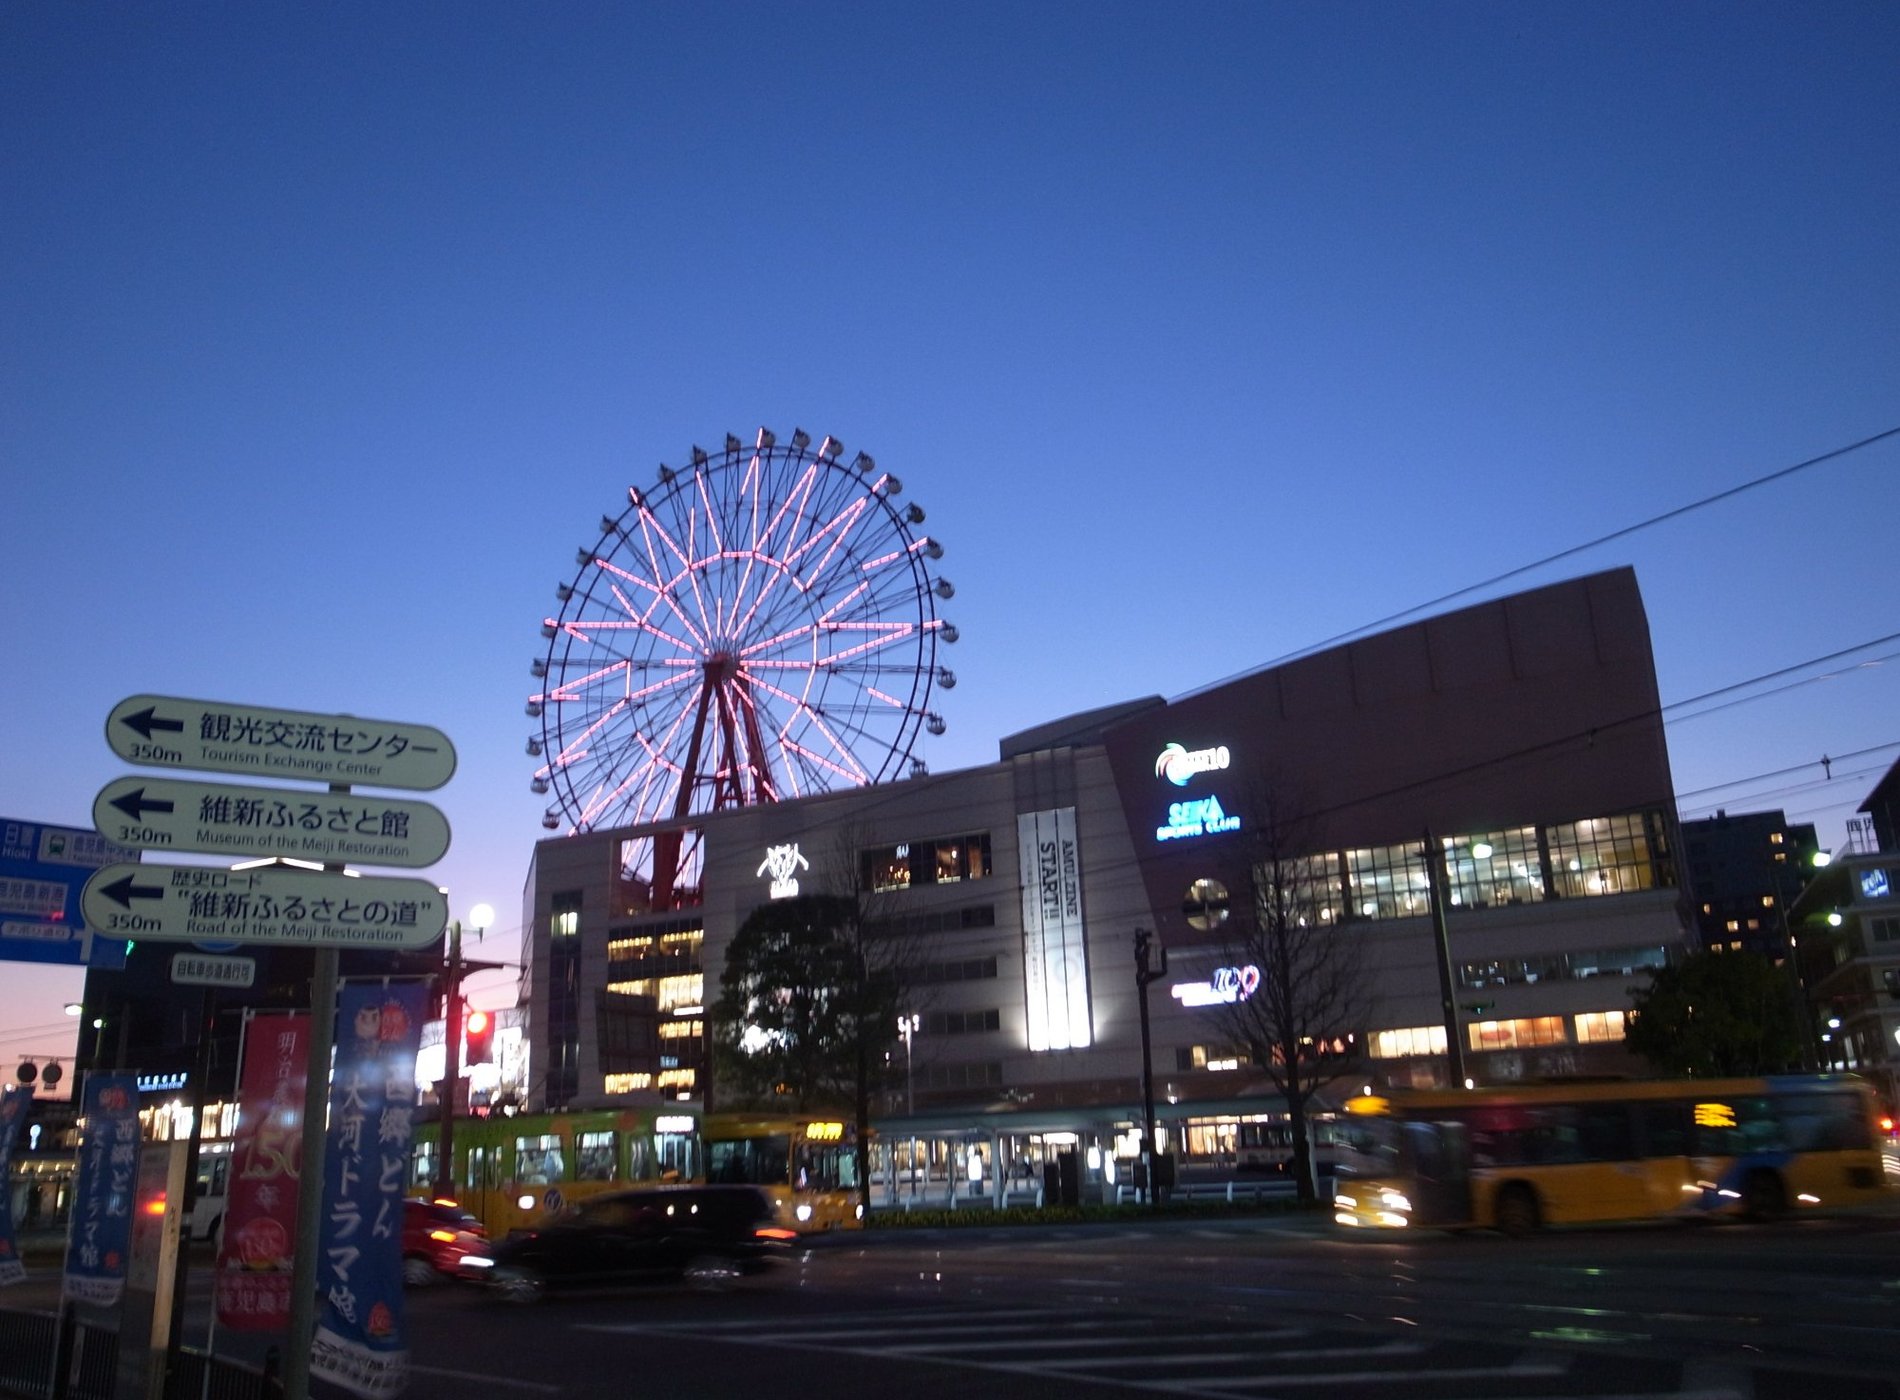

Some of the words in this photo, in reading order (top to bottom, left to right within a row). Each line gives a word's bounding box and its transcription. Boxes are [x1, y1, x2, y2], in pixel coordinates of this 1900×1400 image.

[200, 712, 438, 759] 観光交流センター
[129, 743, 182, 763] 350m
[201, 747, 259, 765] Tourism
[265, 751, 332, 773] Exchange
[337, 759, 382, 776] Center
[200, 795, 410, 839] 維新ふるさと館
[118, 826, 173, 846] 350m
[196, 829, 254, 846] Museum
[258, 832, 272, 846] of
[277, 833, 298, 848] the
[302, 837, 335, 855] Meiji
[339, 839, 409, 856] Restoration
[171, 869, 262, 889] 歴史ロード
[1040, 841, 1060, 920] START!!
[107, 913, 162, 932] 350m
[186, 920, 226, 934] Road
[231, 920, 247, 934] of
[253, 922, 276, 935] the
[281, 924, 317, 940] Meiji
[322, 926, 404, 941] Restoration
